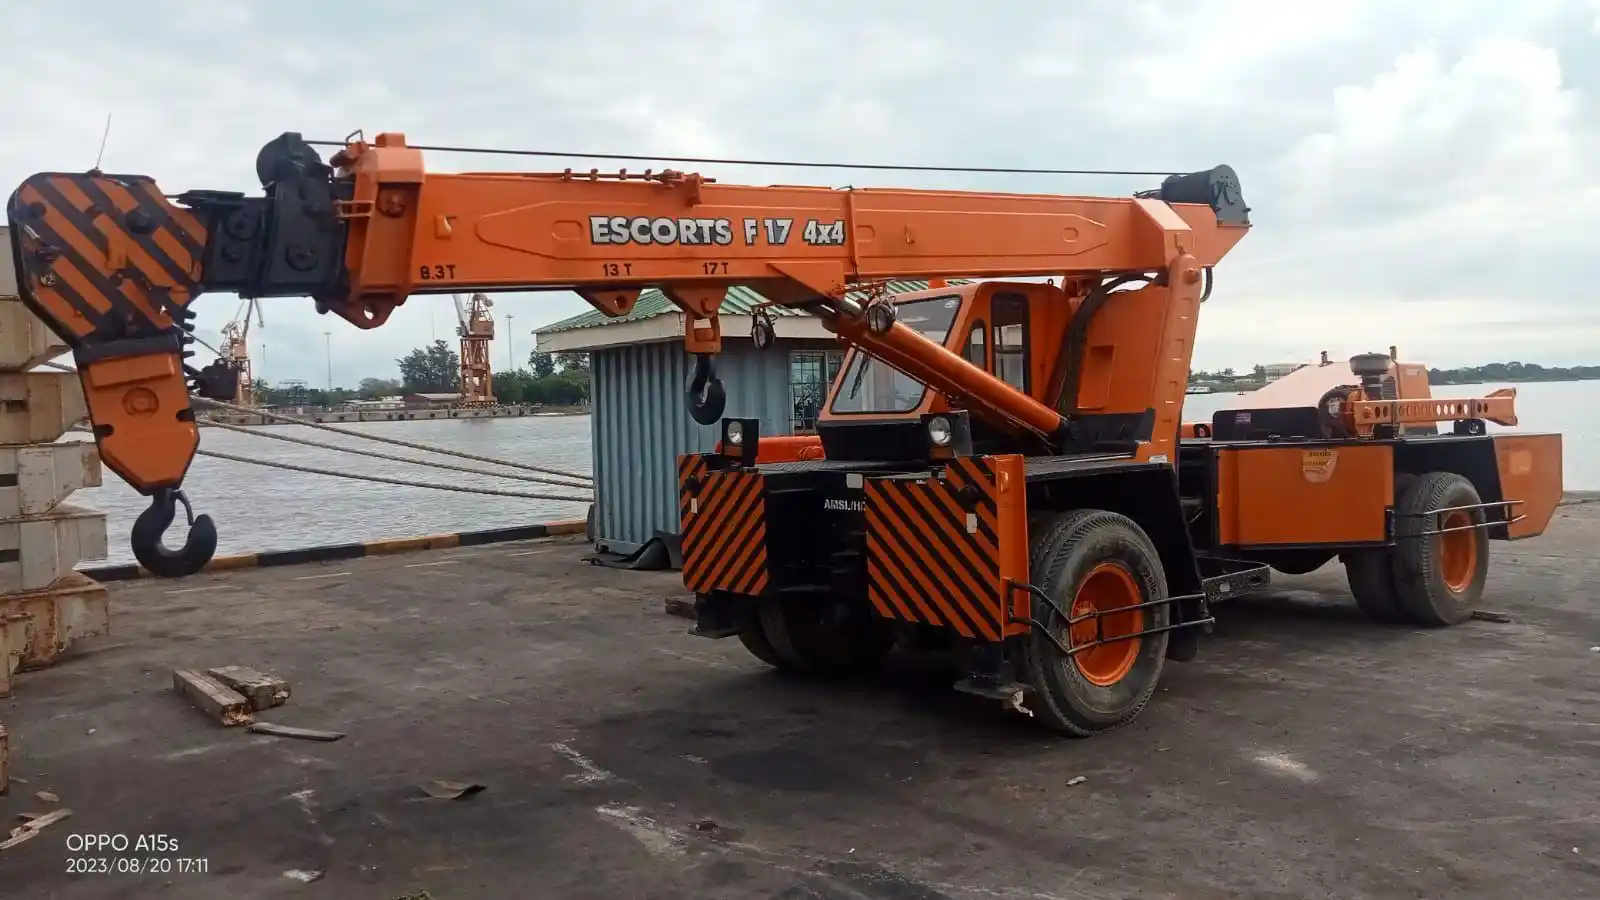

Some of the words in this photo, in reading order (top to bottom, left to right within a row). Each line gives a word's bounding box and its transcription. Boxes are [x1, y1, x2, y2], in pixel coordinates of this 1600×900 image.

[590, 216, 732, 246] ESCORTS
[743, 219, 758, 246] F
[763, 218, 793, 246] 17
[803, 219, 846, 246] 4x4
[602, 263, 619, 277] 13
[702, 262, 718, 275] 17
